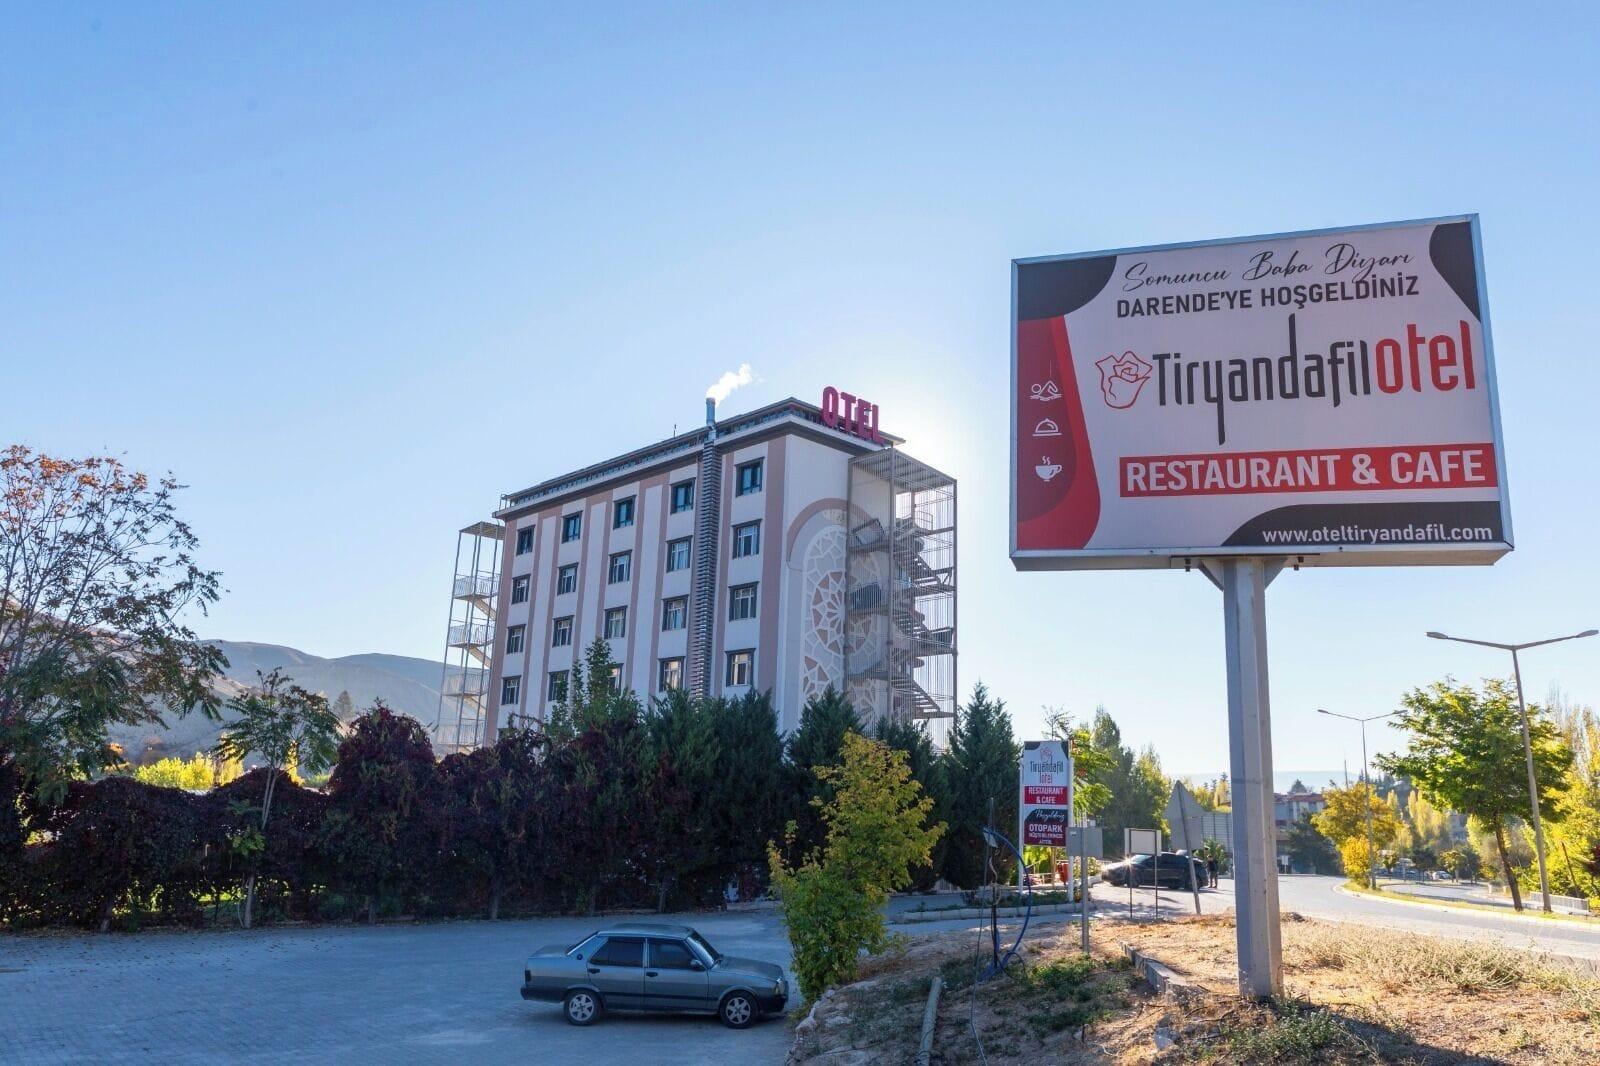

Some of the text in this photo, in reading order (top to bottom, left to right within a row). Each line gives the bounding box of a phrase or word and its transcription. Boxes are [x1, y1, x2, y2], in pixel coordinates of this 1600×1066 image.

[1122, 243, 1415, 292] Somuncu Baba Diyarı
[1116, 272, 1420, 318] DARENDE'YE HOŞGELDİNİZ
[822, 386, 886, 446] OTEL
[1126, 449, 1486, 492] RESTAURANT & CAFE
[1262, 523, 1493, 544] www.oteltiryandafil.com
[1028, 786, 1064, 795] RESTAURANT
[1041, 796, 1057, 804] CAFE
[1029, 823, 1063, 833] OTOPARK
